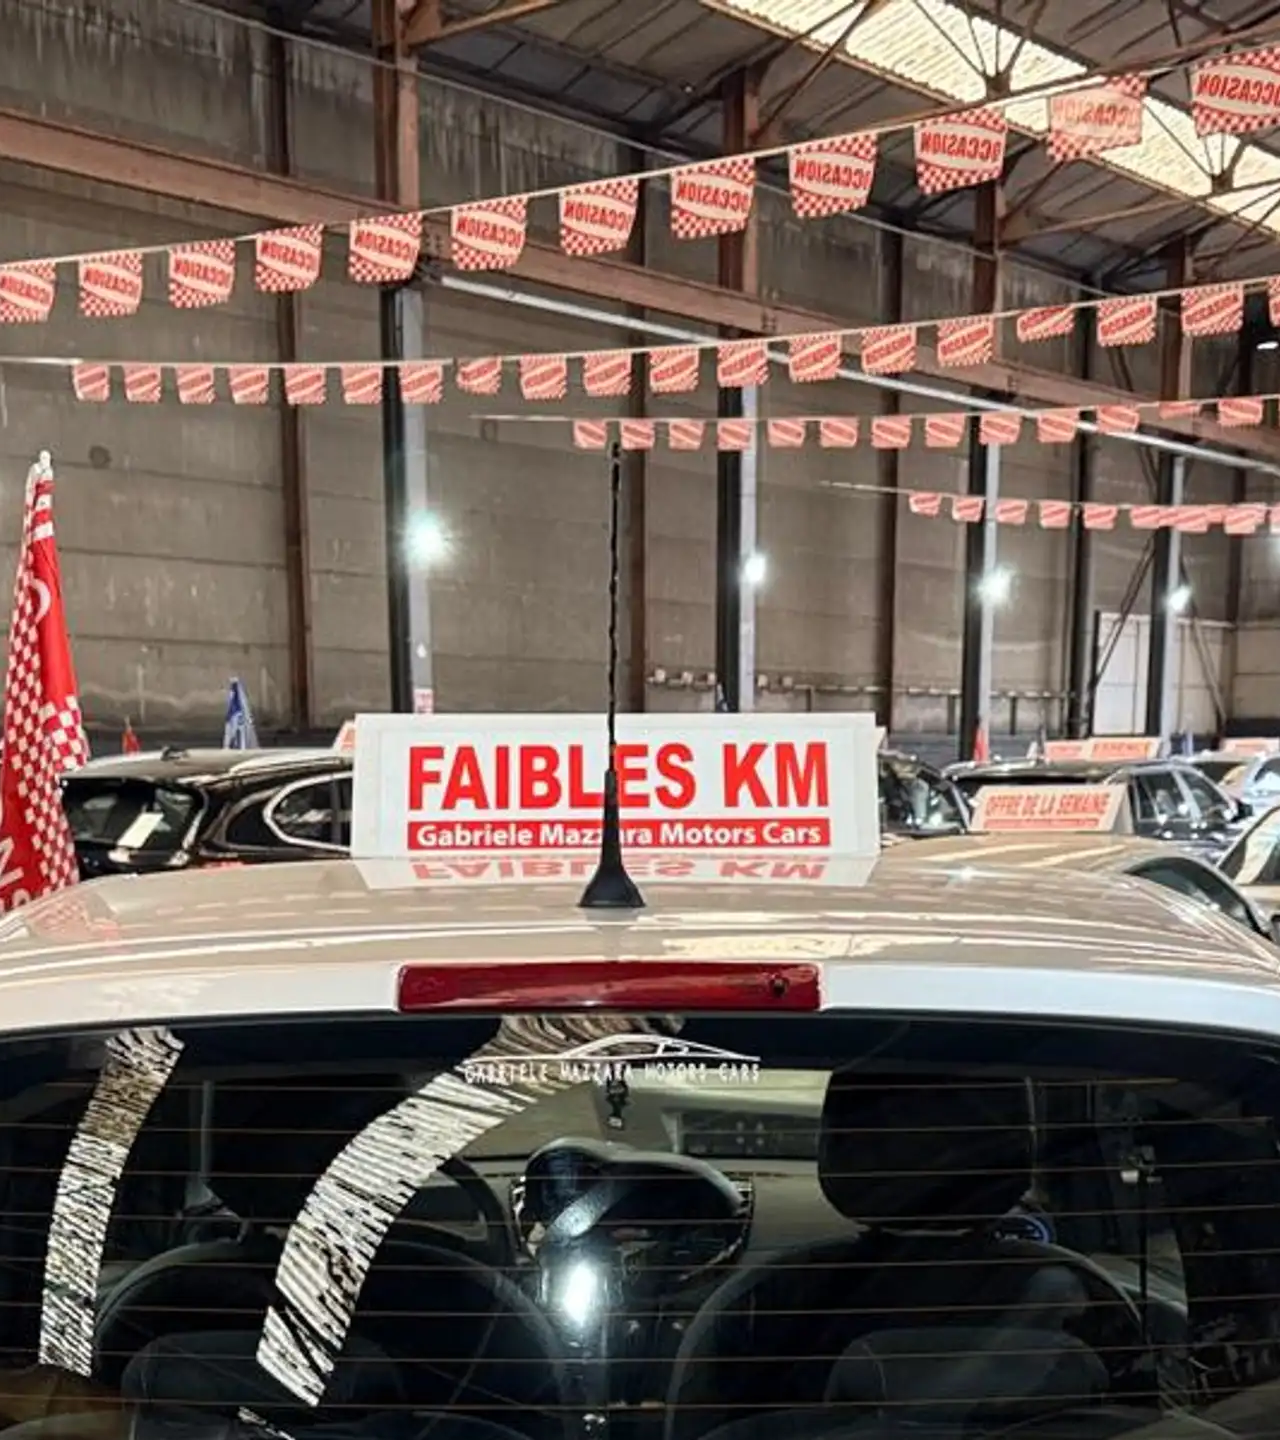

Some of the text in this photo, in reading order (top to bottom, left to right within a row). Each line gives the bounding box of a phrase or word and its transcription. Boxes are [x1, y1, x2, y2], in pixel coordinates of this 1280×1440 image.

[408, 742, 830, 811] FAIBLES KM
[416, 821, 822, 847] Gabriele Mazra Motors Cars
[560, 1063, 634, 1084] MAZZARA
[644, 1063, 707, 1082] MOTORS
[718, 1063, 760, 1083] CARS
